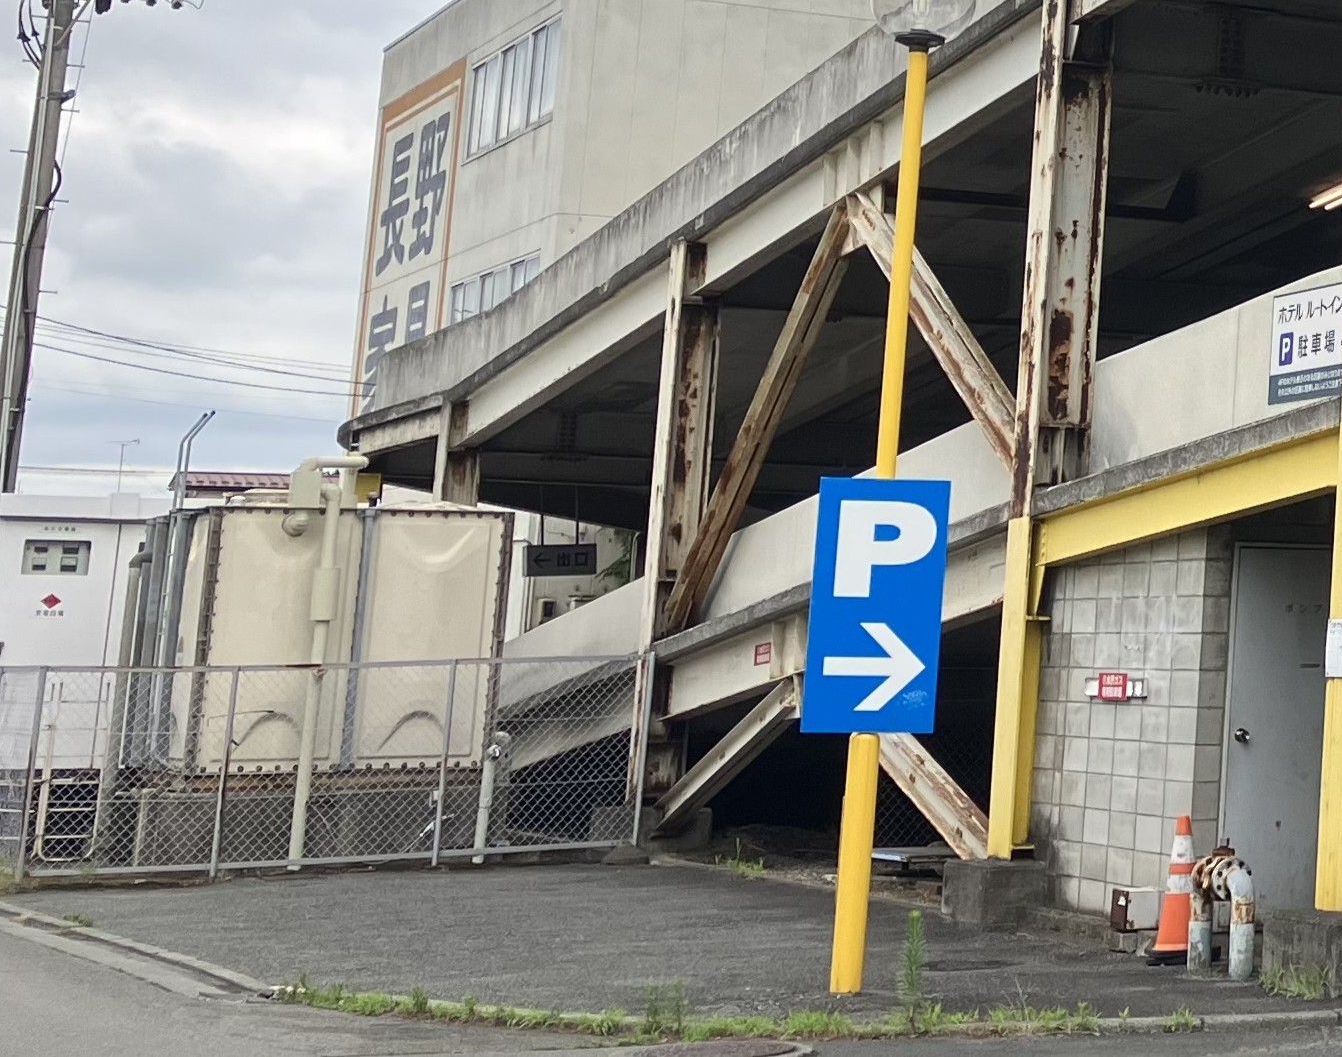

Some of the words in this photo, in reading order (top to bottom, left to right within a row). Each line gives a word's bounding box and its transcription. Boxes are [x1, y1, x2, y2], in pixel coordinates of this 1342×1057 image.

[375, 111, 451, 278] 長野
[1277, 303, 1303, 325] ホテル
[1297, 329, 1337, 359] 駐車場
[833, 499, 938, 598] P
